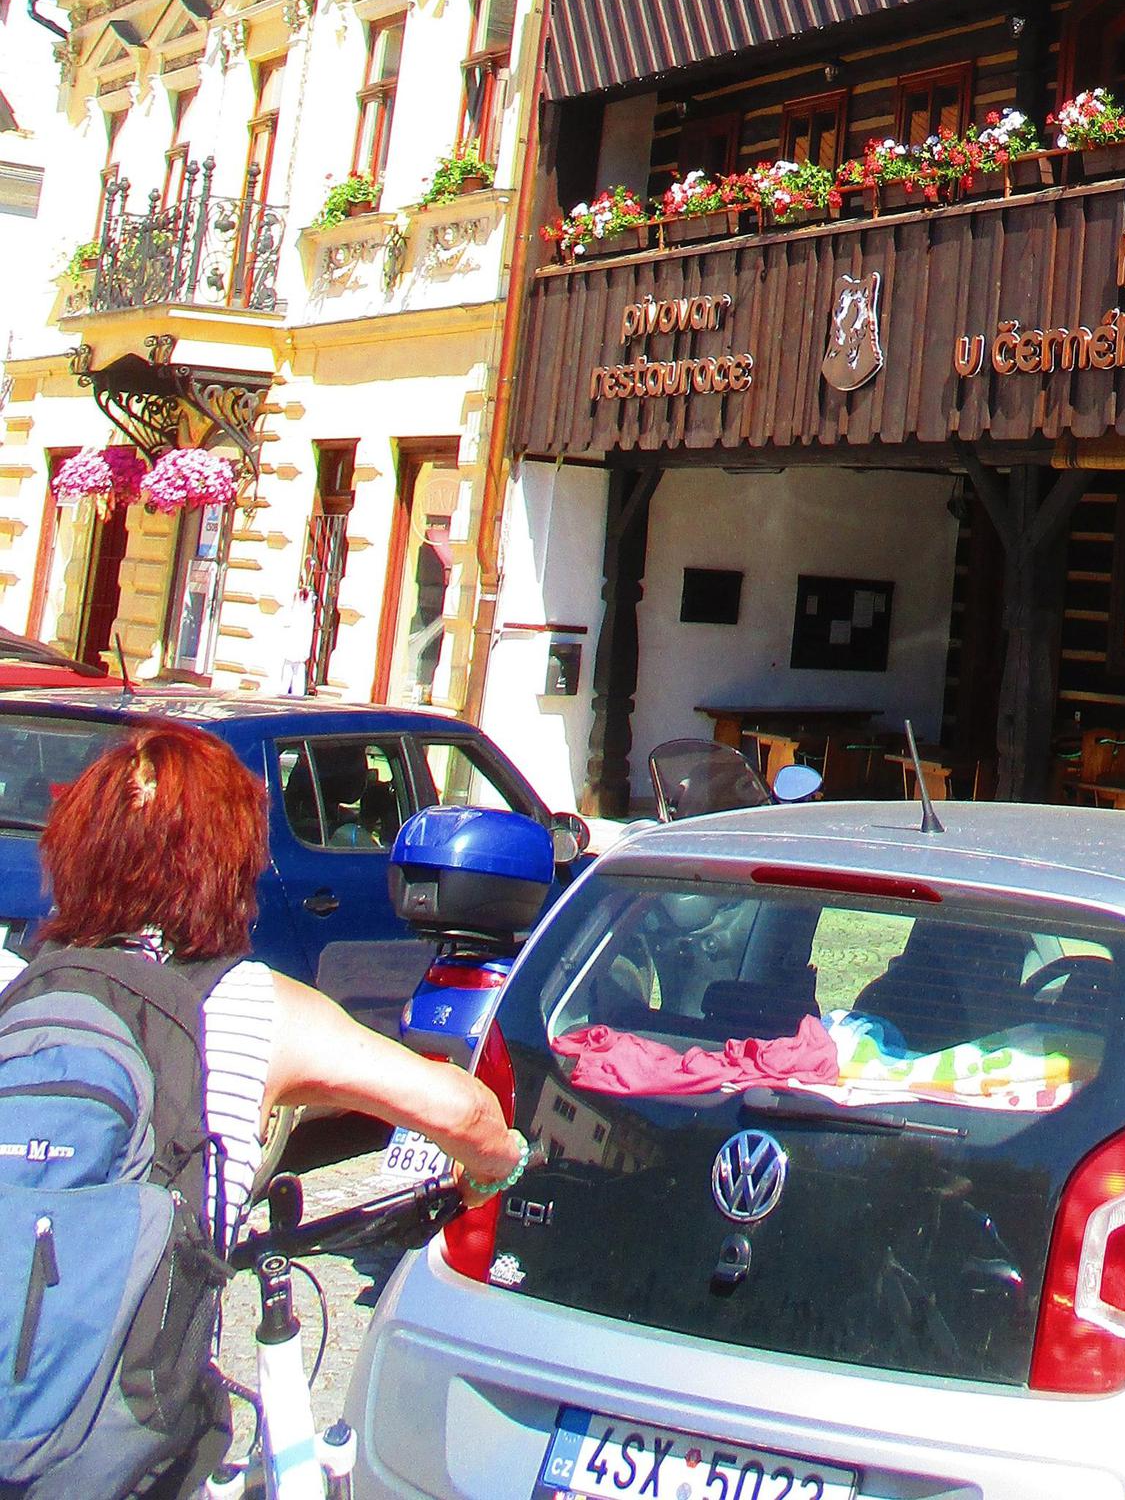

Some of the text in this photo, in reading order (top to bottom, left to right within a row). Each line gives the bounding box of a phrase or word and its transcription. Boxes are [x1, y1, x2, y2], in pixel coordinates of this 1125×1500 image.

[620, 294, 731, 347] pivovar
[589, 353, 754, 401] restaurace
[955, 335, 984, 378] u
[388, 1146, 442, 1175] 8834
[506, 1197, 554, 1227] up!
[550, 1457, 574, 1478] CZ
[586, 1427, 675, 1497] 4SX
